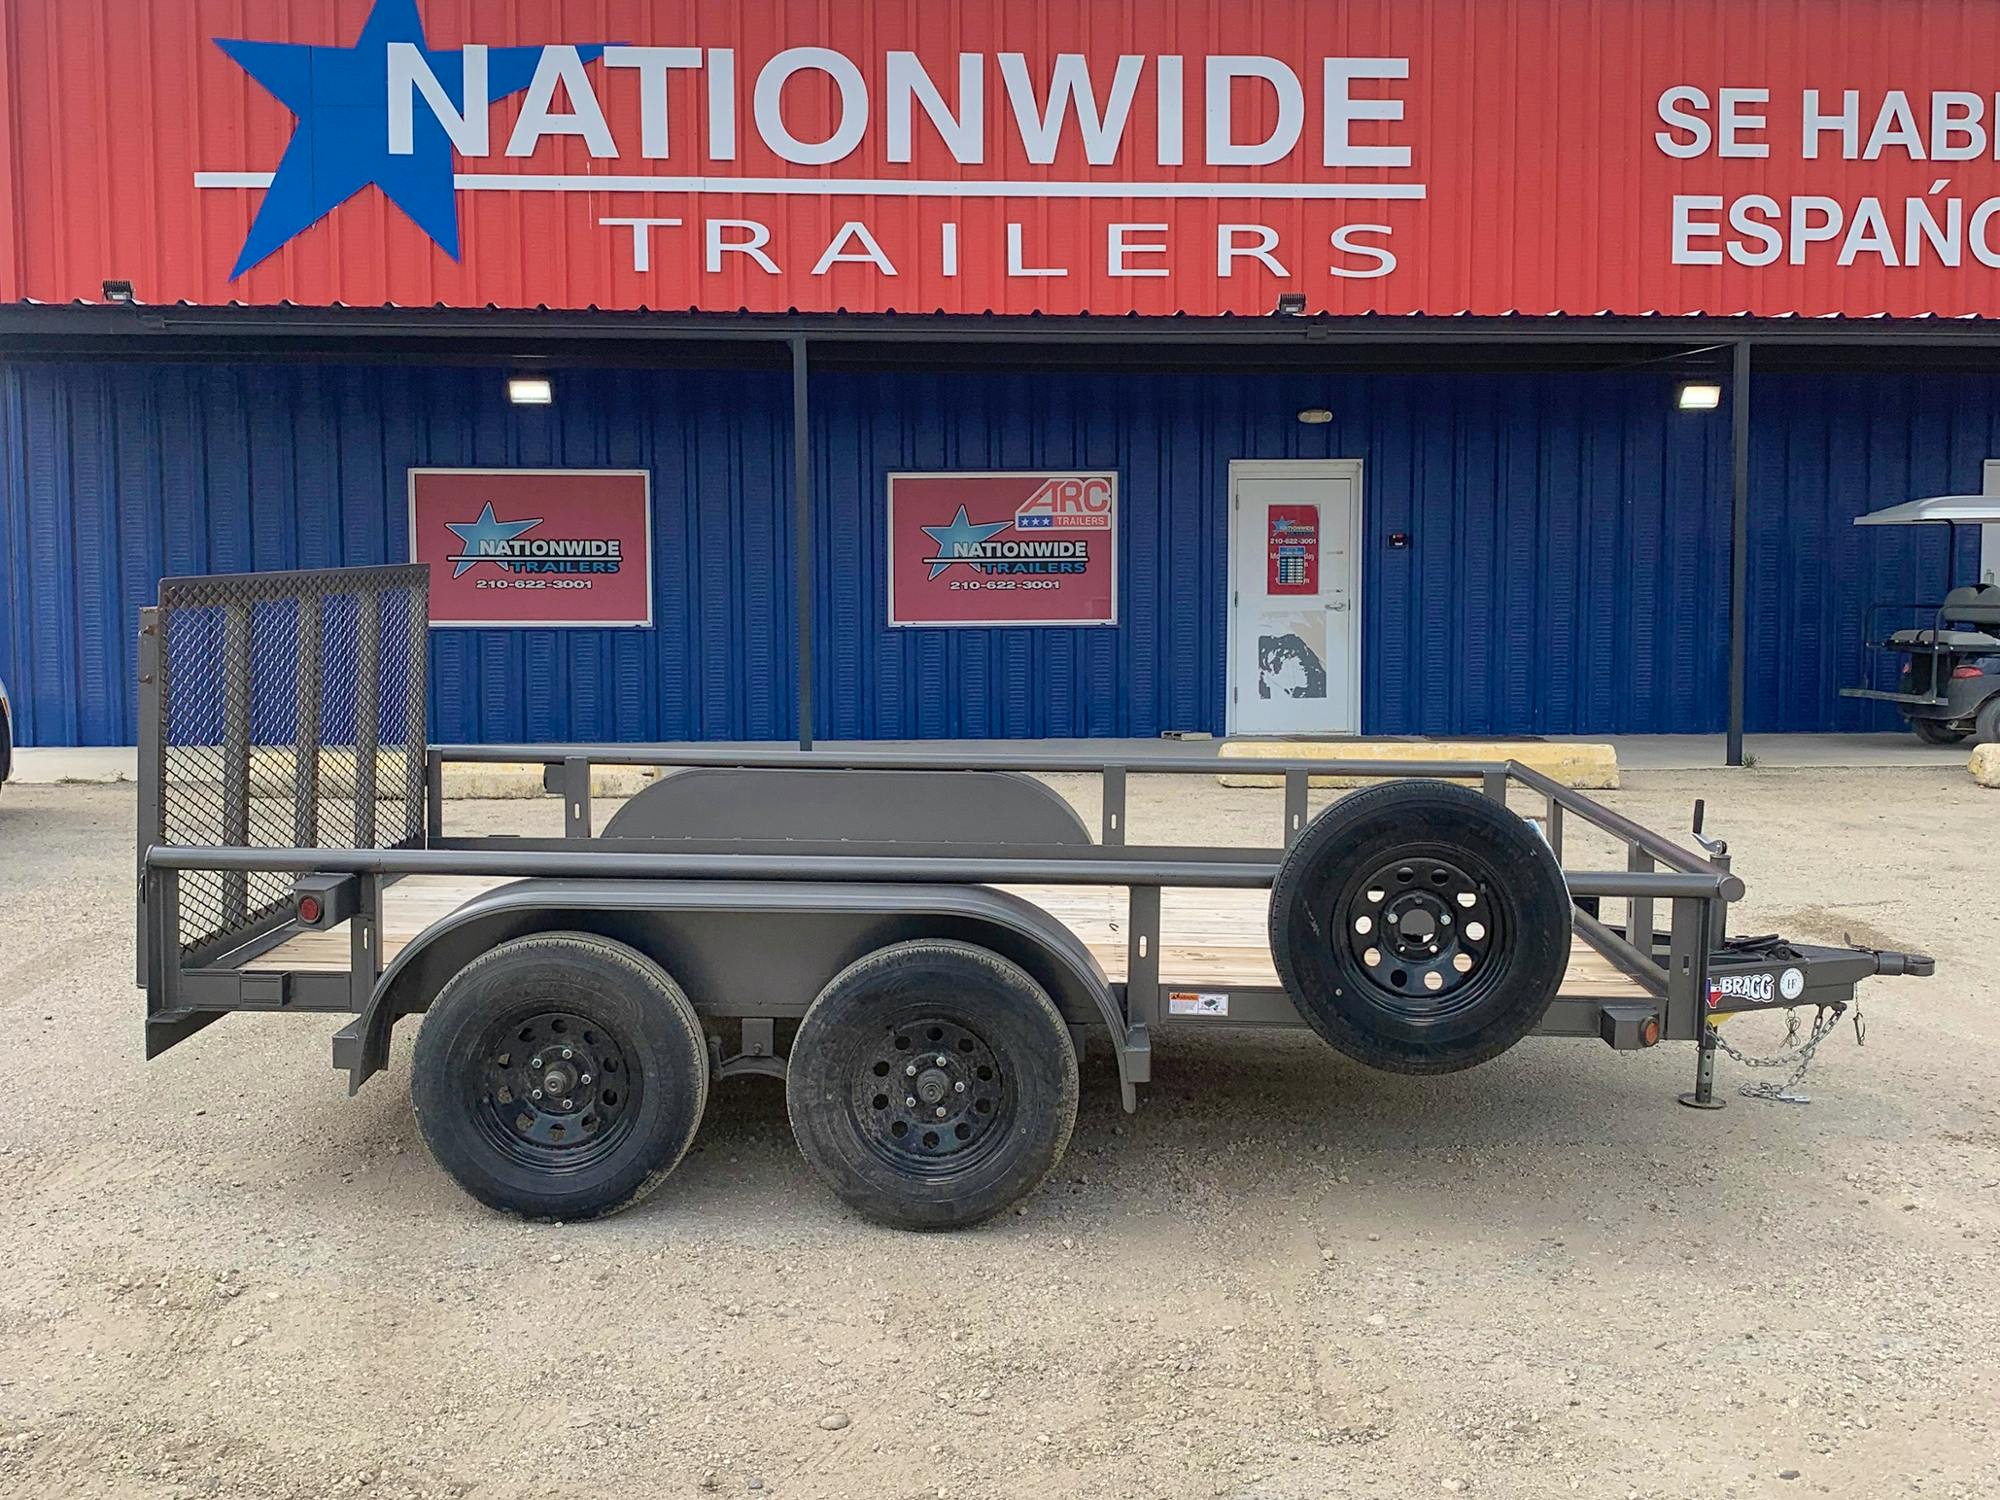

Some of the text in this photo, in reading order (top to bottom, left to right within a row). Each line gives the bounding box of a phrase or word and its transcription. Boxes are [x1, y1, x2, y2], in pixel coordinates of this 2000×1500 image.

[386, 41, 1412, 167] NATIONWIDE
[1654, 85, 2000, 161] SE HAB
[598, 217, 1397, 279] TRAILERS
[1022, 480, 1110, 513] ARC
[1056, 516, 1105, 526] TRAILERS
[478, 539, 620, 556] NATIONWIDE
[953, 541, 1087, 557] NATIONWIDE
[511, 561, 620, 573] TRAILERS
[982, 562, 1087, 573] TRAILERS
[475, 579, 593, 589] 210-622-3001
[950, 581, 1060, 590] 210-622-3001
[1721, 974, 1773, 1001] BRAGG
